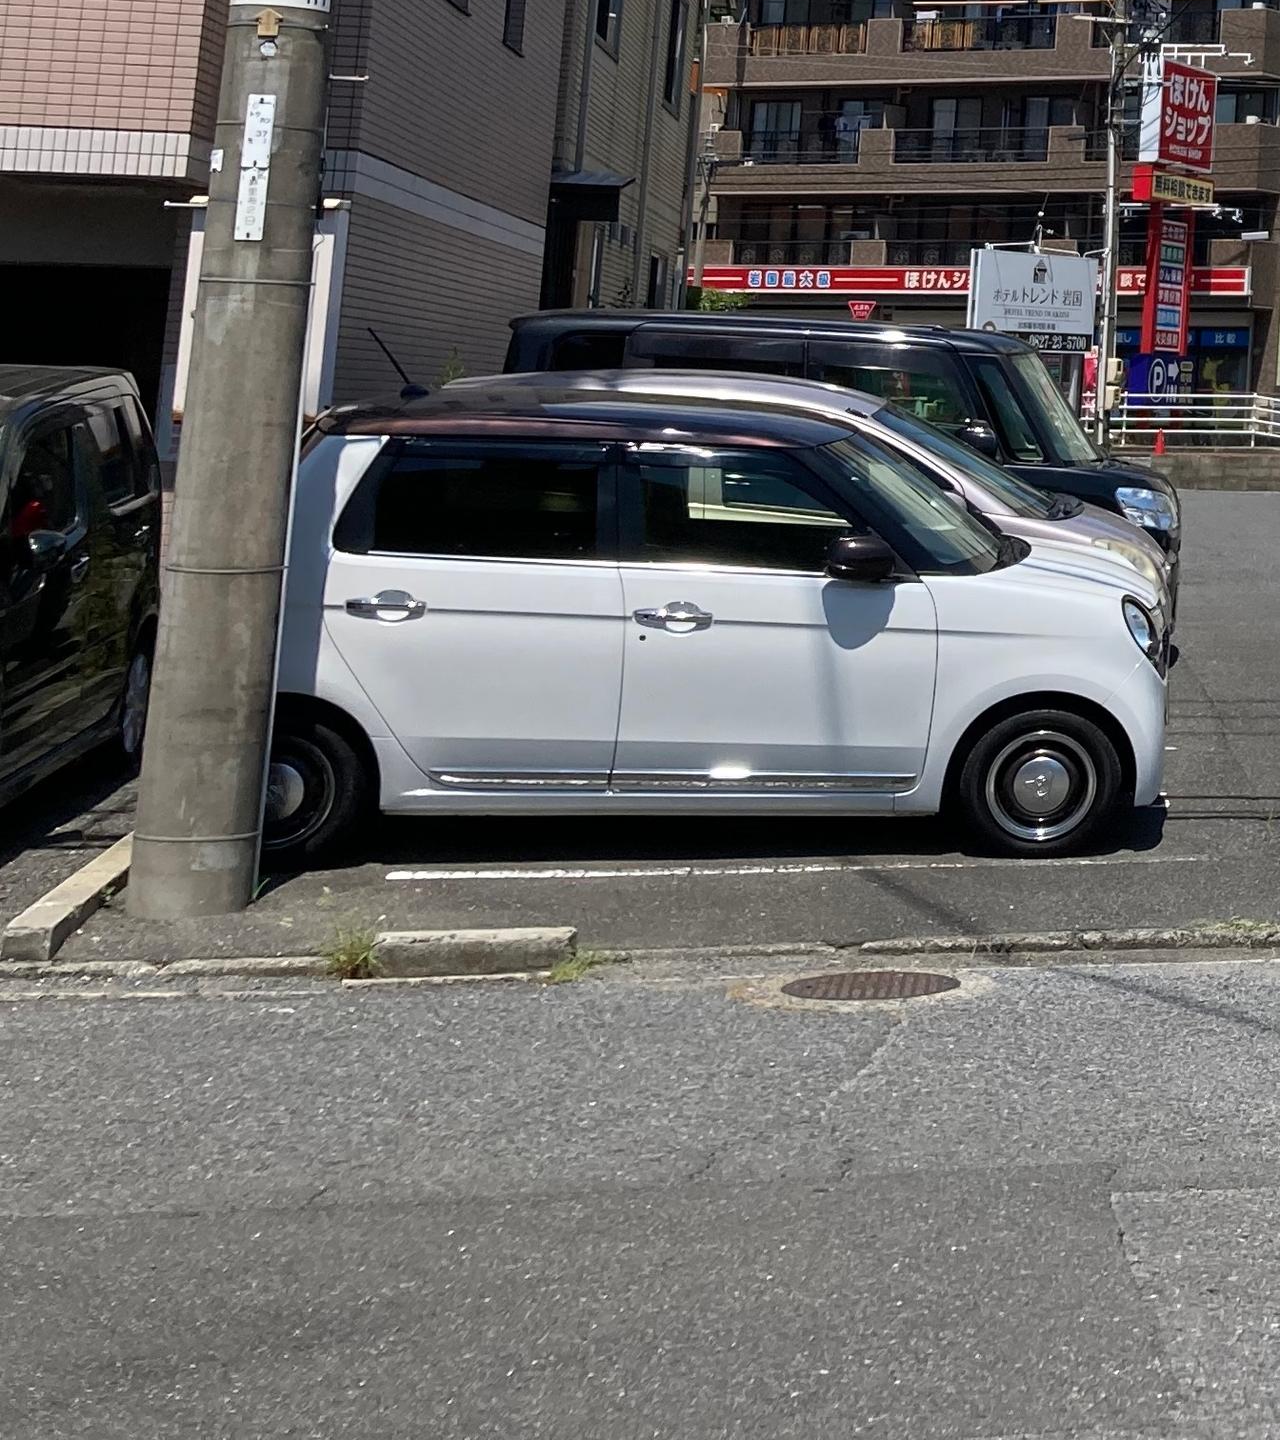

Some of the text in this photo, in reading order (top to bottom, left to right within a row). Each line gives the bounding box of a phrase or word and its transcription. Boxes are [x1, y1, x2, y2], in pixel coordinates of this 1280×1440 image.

[1168, 72, 1211, 113] ほけん
[1164, 106, 1212, 146] ショップ
[748, 270, 831, 288] 岩国最大級
[993, 286, 1083, 307] ホテルトレンド 岩国
